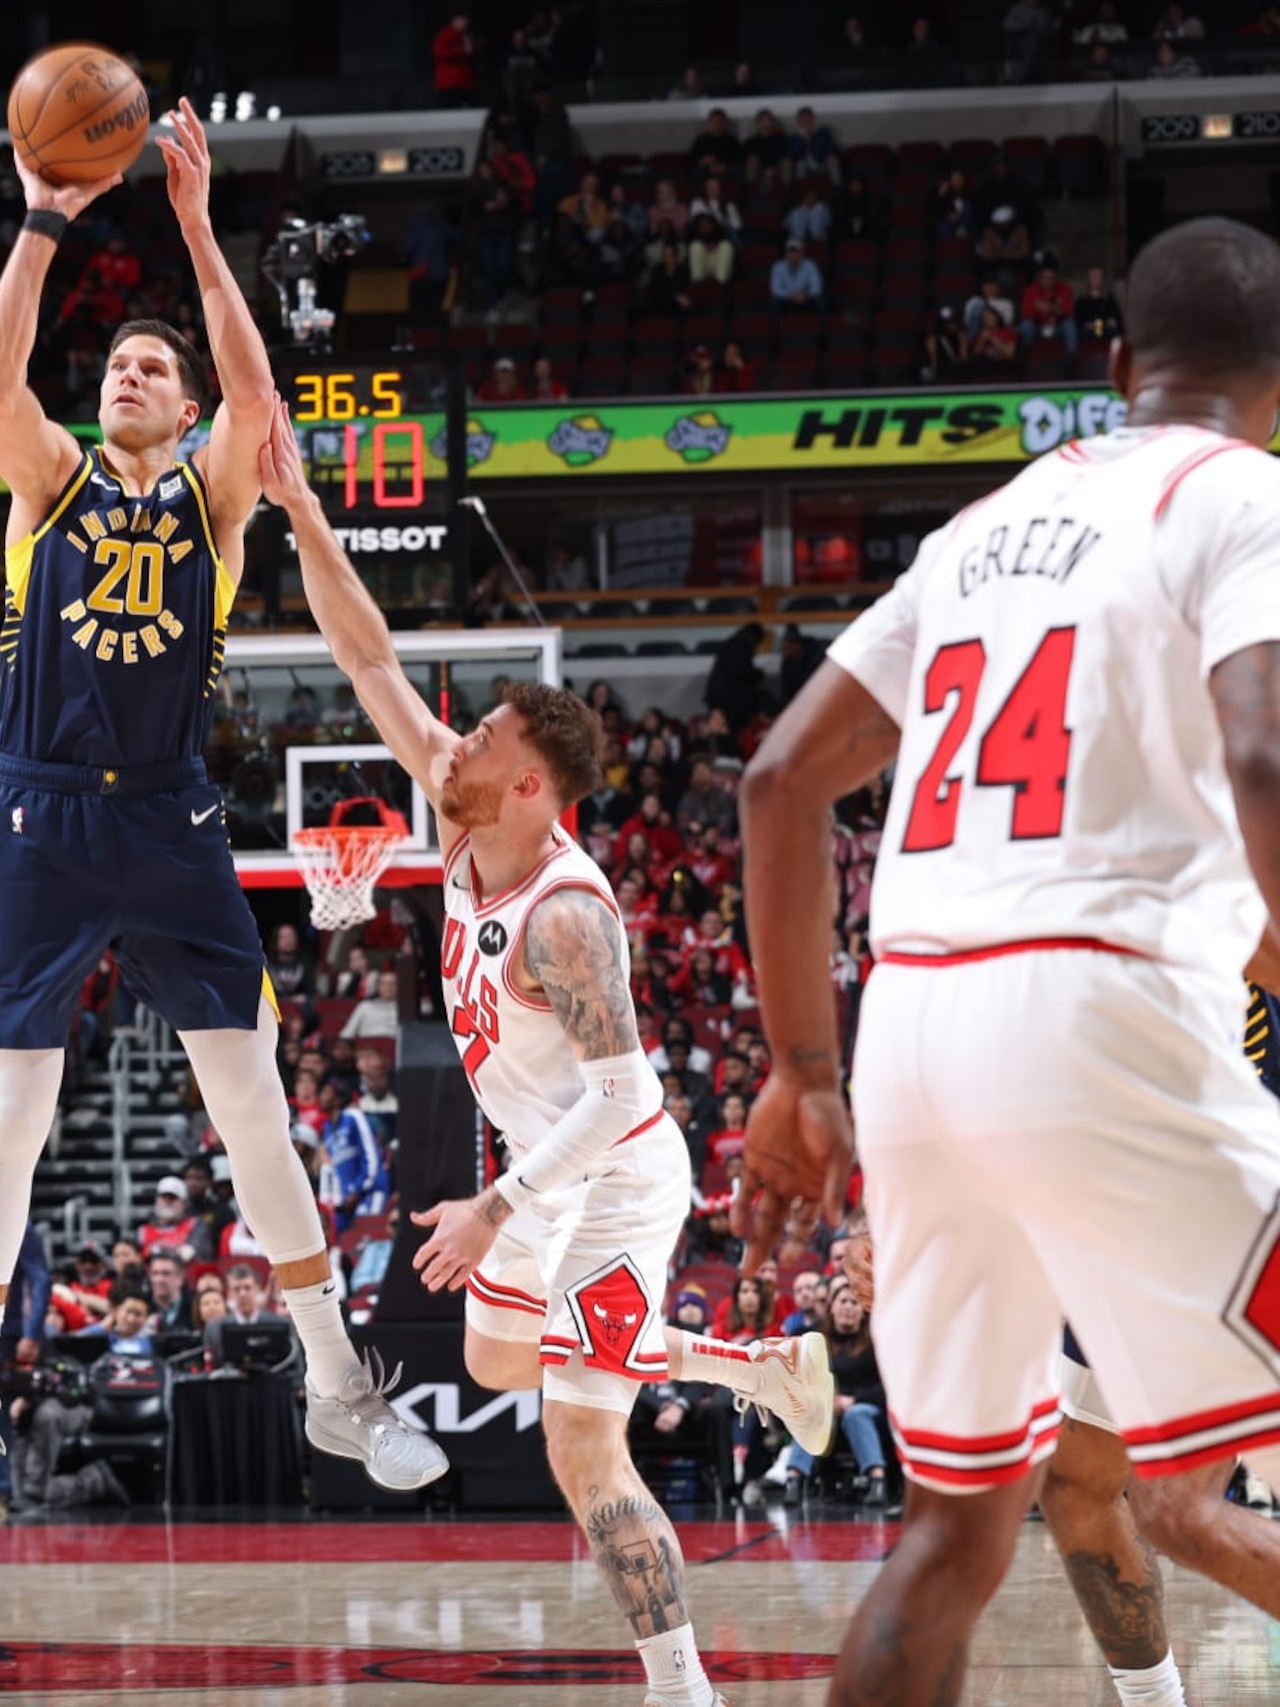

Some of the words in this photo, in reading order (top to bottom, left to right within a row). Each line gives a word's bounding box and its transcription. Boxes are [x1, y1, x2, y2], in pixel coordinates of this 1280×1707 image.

[1147, 115, 1196, 140] 209
[295, 372, 402, 421] 36.5
[792, 404, 1005, 450] HITS
[343, 421, 424, 508] 10
[66, 502, 194, 564] INDIANA
[333, 526, 447, 553] TISSOT
[958, 517, 1102, 598] GREEN
[86, 538, 165, 616] 20
[60, 598, 185, 664] PACERS
[899, 624, 1078, 854] 24
[453, 1004, 491, 1097] 7
